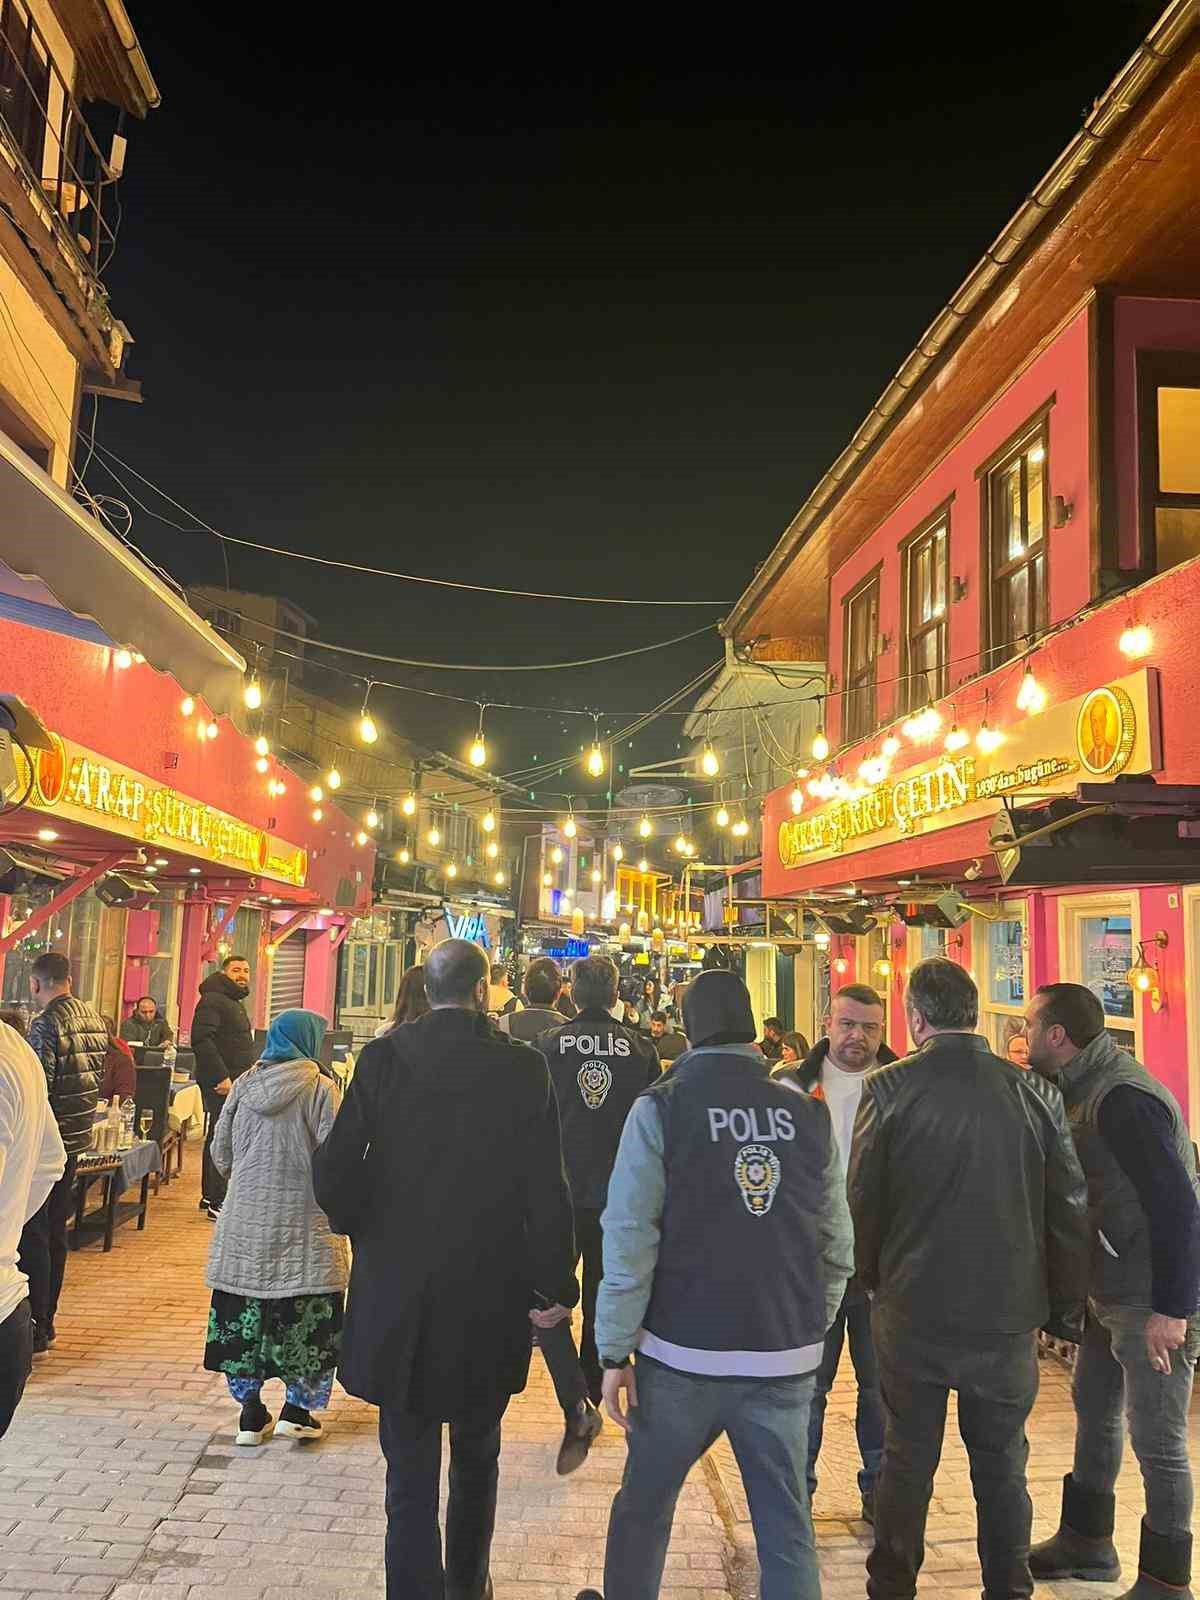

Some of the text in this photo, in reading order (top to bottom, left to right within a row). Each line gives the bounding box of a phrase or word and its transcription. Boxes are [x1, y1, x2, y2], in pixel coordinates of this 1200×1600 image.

[66, 757, 145, 822] ARAP
[146, 788, 209, 848] ŞÜKRÜ
[791, 814, 826, 857] ARAP
[893, 756, 972, 833] ÇETİN
[560, 1032, 631, 1057] POLİS
[707, 1107, 796, 1142] POLIS
